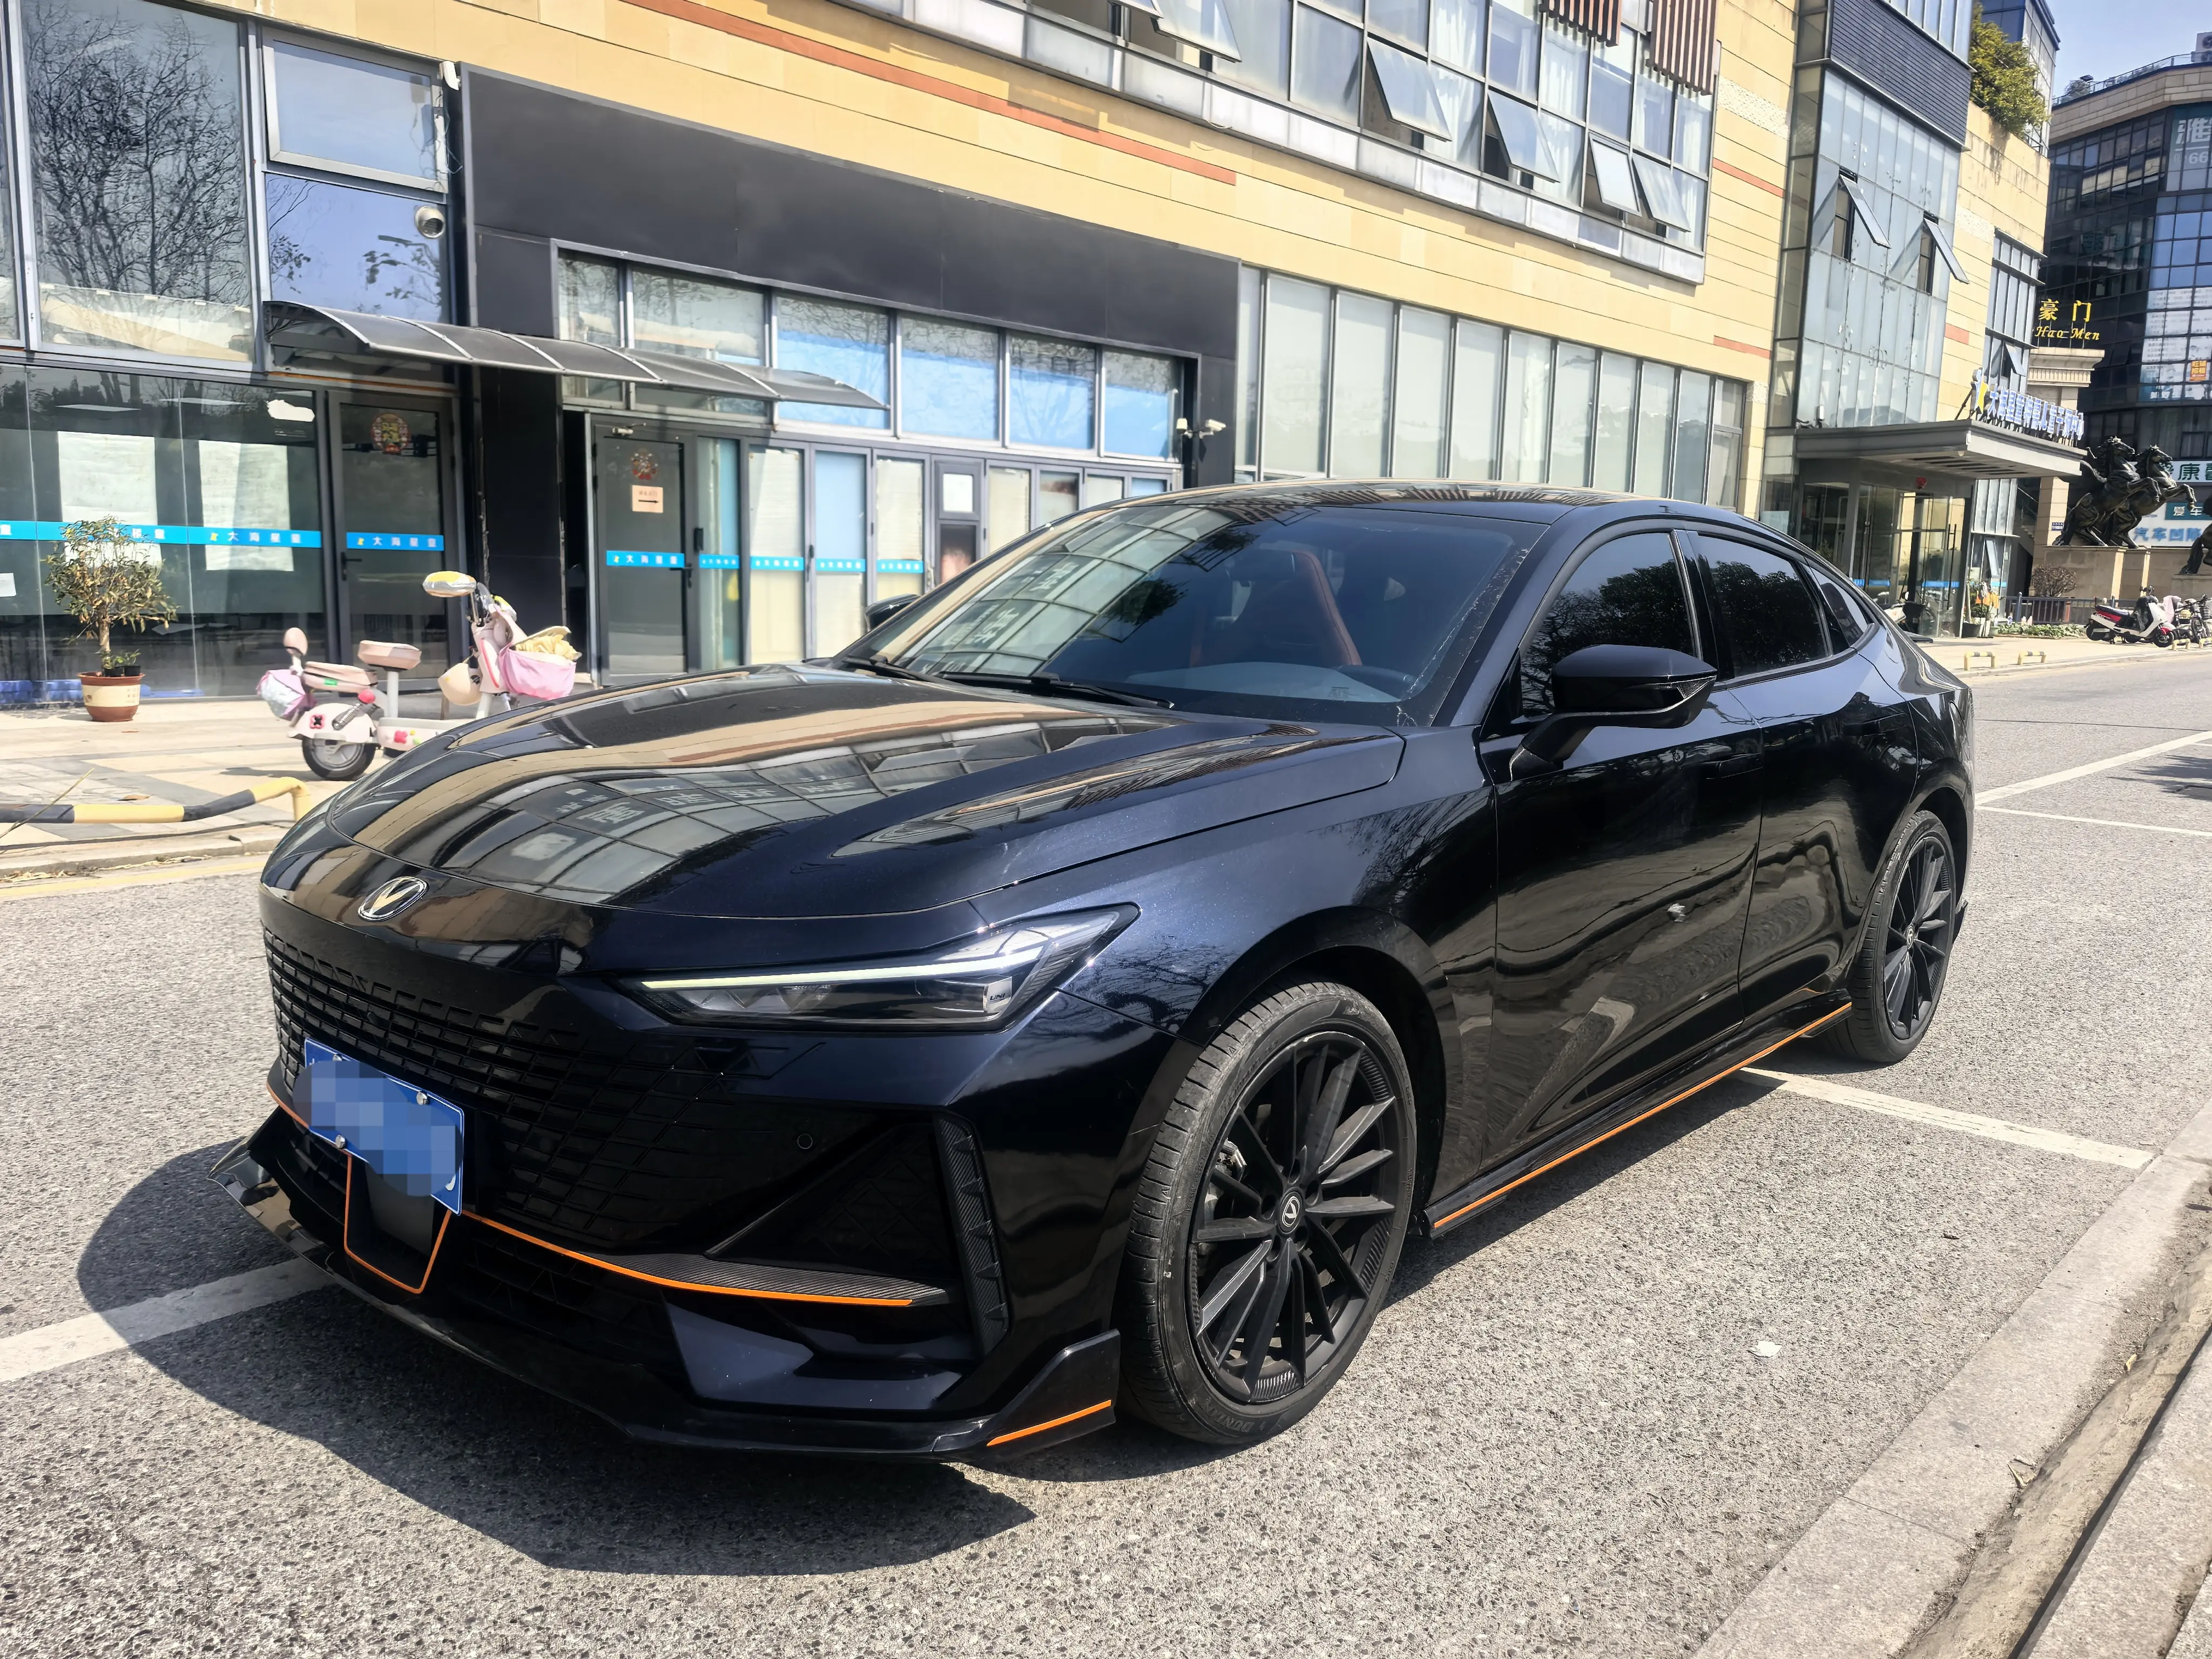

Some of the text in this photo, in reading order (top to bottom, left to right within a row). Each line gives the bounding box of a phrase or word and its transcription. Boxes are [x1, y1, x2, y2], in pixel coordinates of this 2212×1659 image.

[2176, 117, 2212, 145] 雅
[2188, 151, 2212, 164] 66
[2039, 298, 2093, 322] 豪门
[2034, 326, 2100, 340] Hao Men
